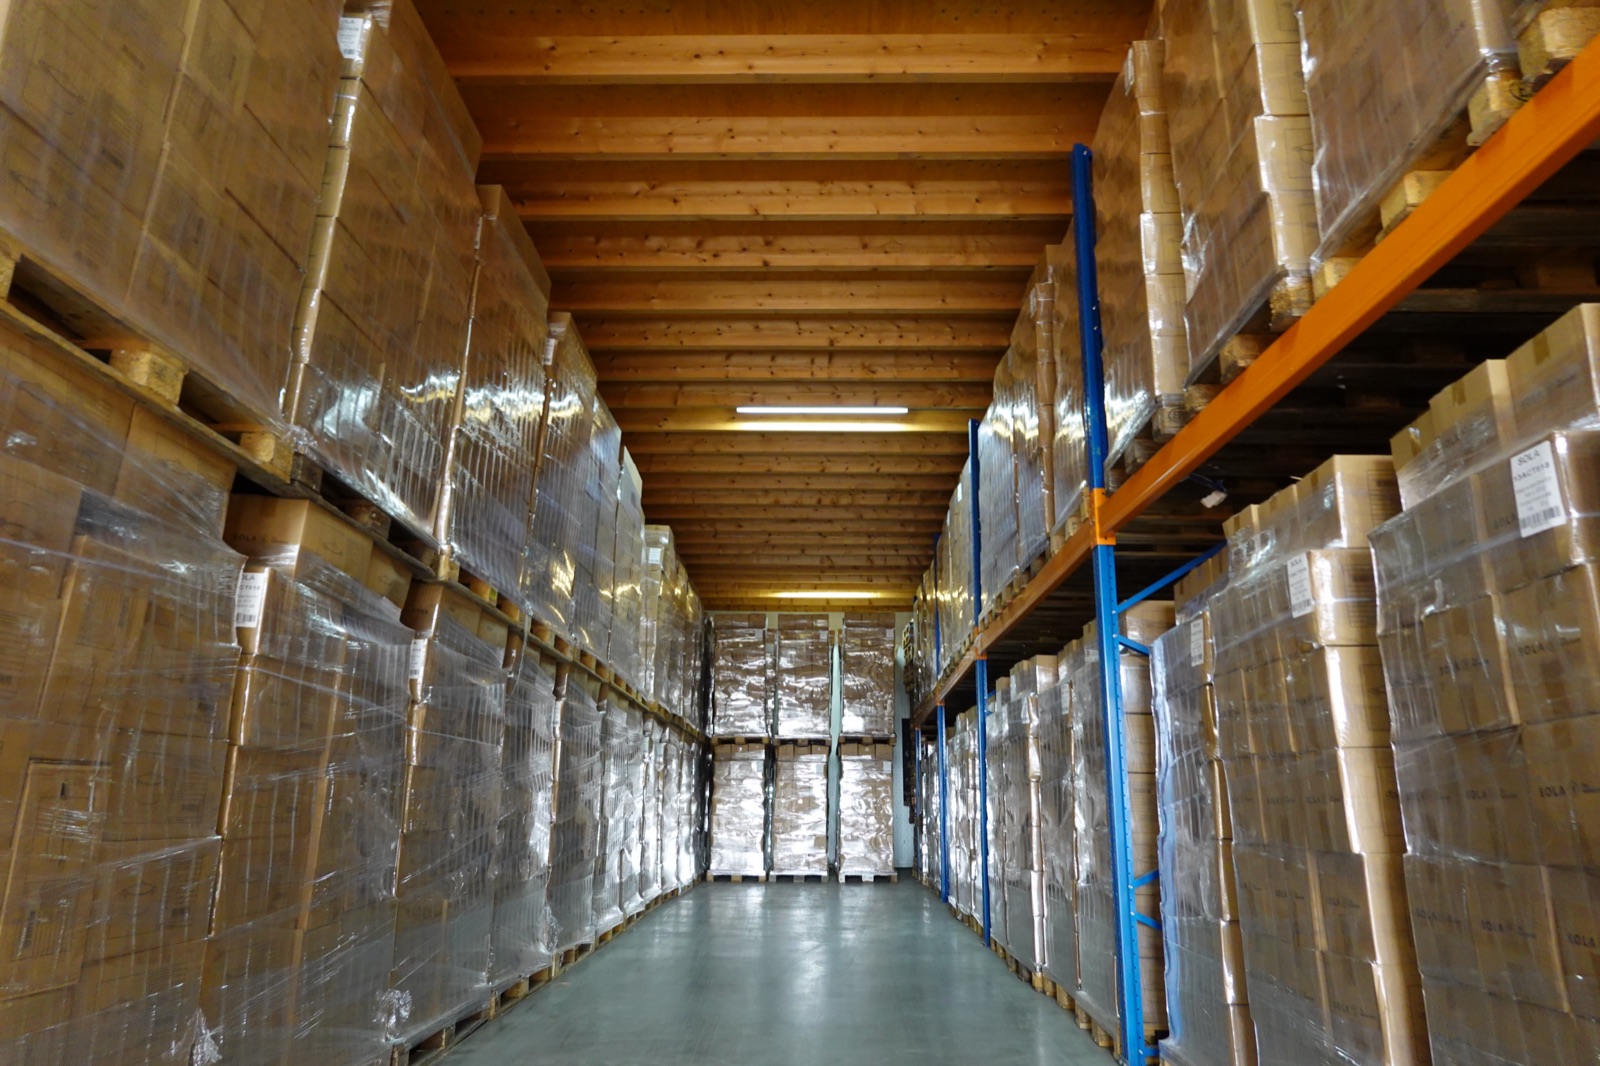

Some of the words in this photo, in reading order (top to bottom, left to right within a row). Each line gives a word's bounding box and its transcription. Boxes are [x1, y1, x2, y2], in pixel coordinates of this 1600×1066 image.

[1517, 449, 1540, 466] SOLA
[1518, 642, 1546, 657] SOLA
[1439, 661, 1461, 677] SOA
[1538, 784, 1567, 799] SOLA
[1567, 932, 1597, 948] SOLA
